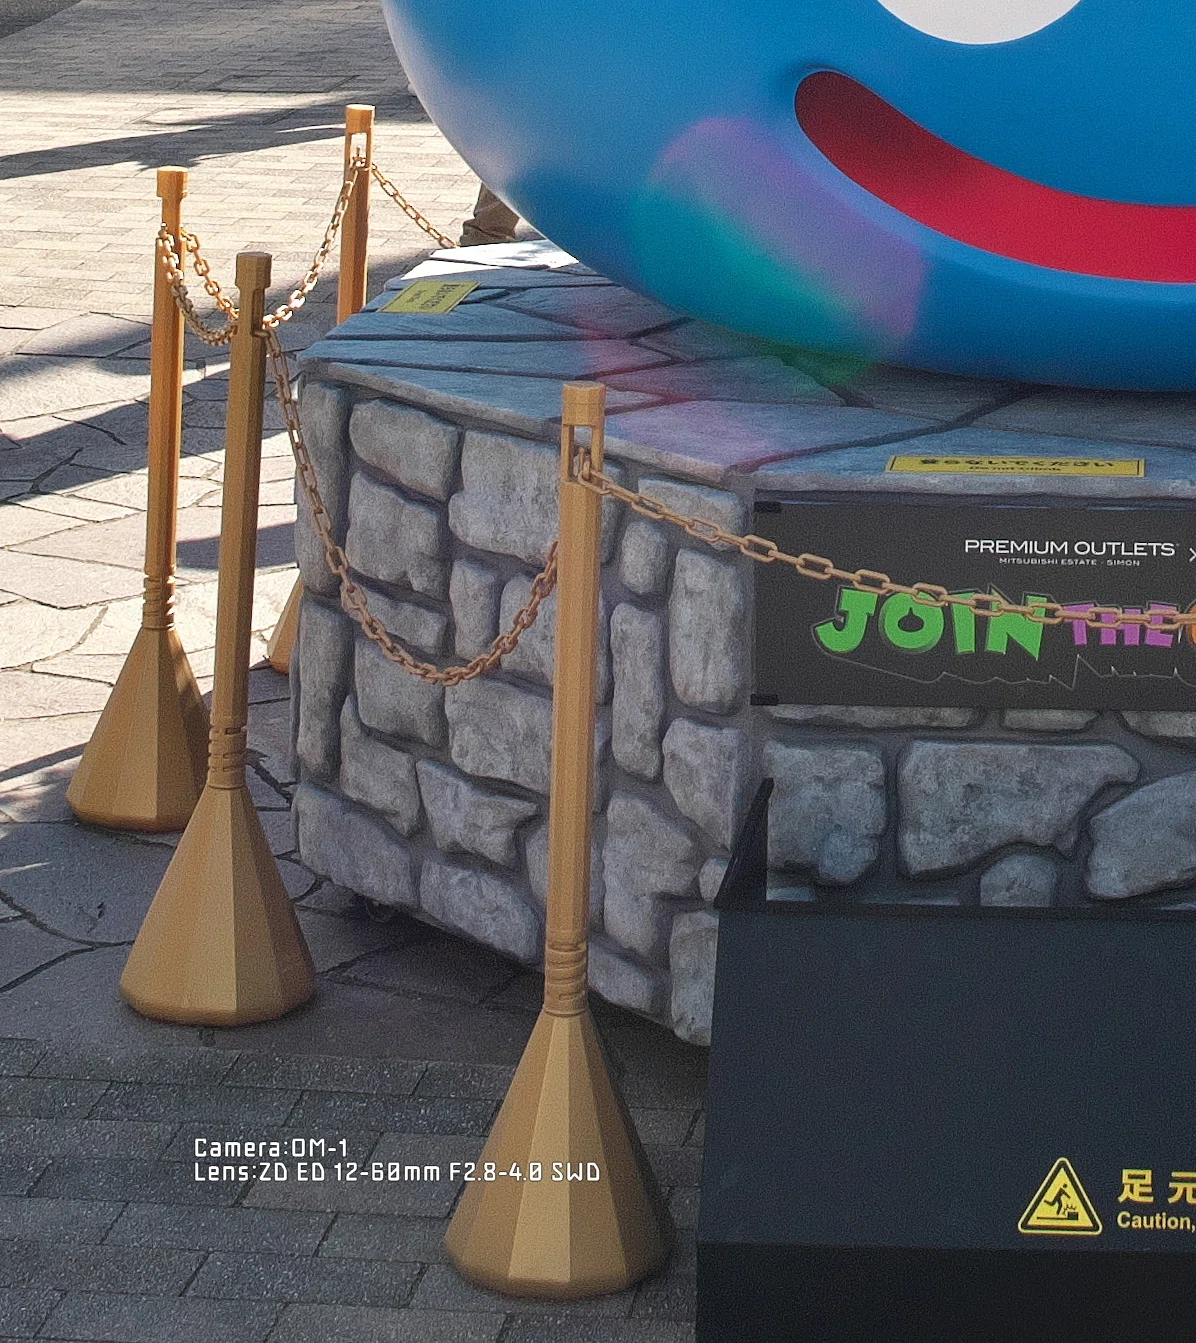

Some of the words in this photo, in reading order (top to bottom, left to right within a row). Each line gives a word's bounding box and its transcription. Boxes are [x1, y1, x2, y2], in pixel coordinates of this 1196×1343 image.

[964, 539, 1068, 555] PREMIUM
[1074, 541, 1176, 557] OUTLETS
[999, 557, 1058, 565] MITSUBISHI
[1061, 558, 1097, 566] ESTATE
[1107, 559, 1140, 567] SIMON
[813, 587, 1048, 661] JOIN
[1062, 602, 1173, 648] THE
[1117, 1210, 1196, 1233] Caution,
